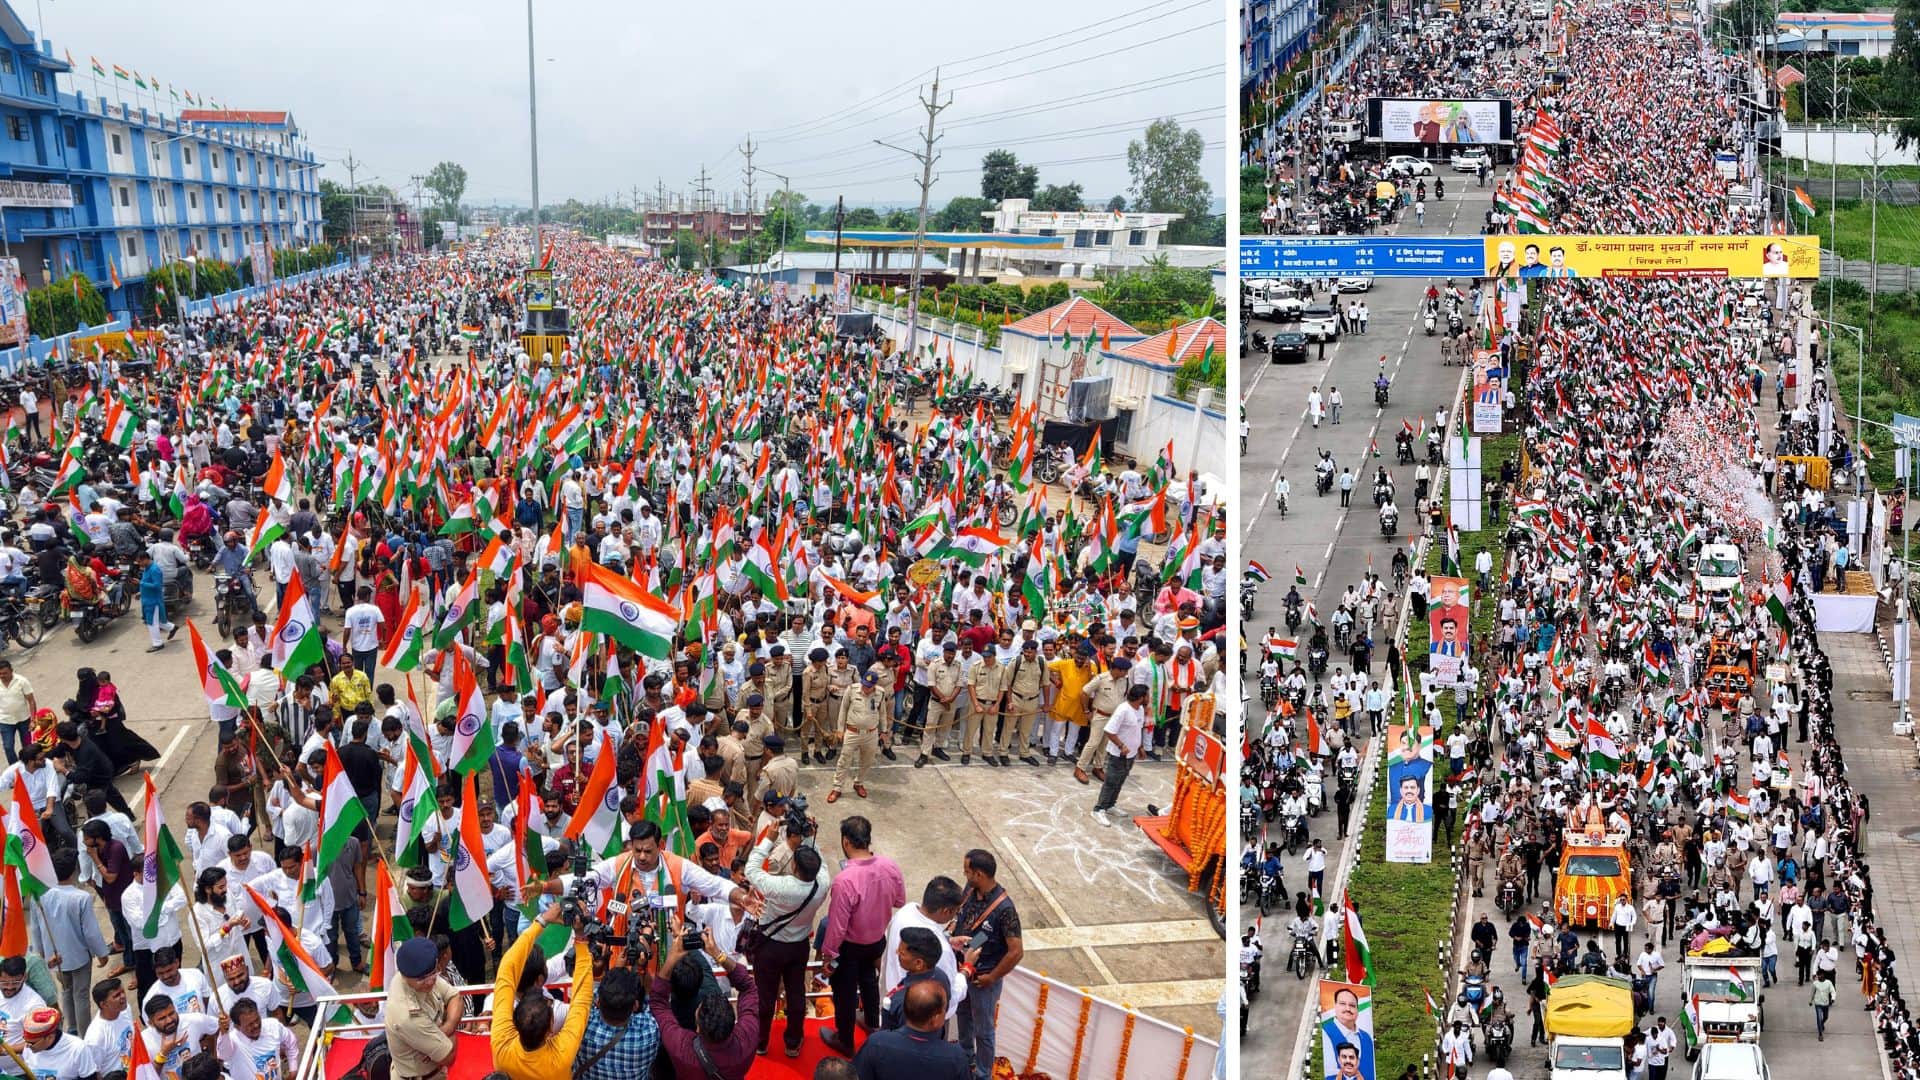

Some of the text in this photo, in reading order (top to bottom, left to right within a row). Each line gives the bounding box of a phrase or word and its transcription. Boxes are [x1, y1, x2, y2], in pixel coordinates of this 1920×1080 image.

[1595, 243, 1625, 252] श्यामा
[1629, 243, 1655, 252] प्रसाद
[1700, 242, 1723, 251] नगर
[1727, 240, 1749, 251] मार्ग
